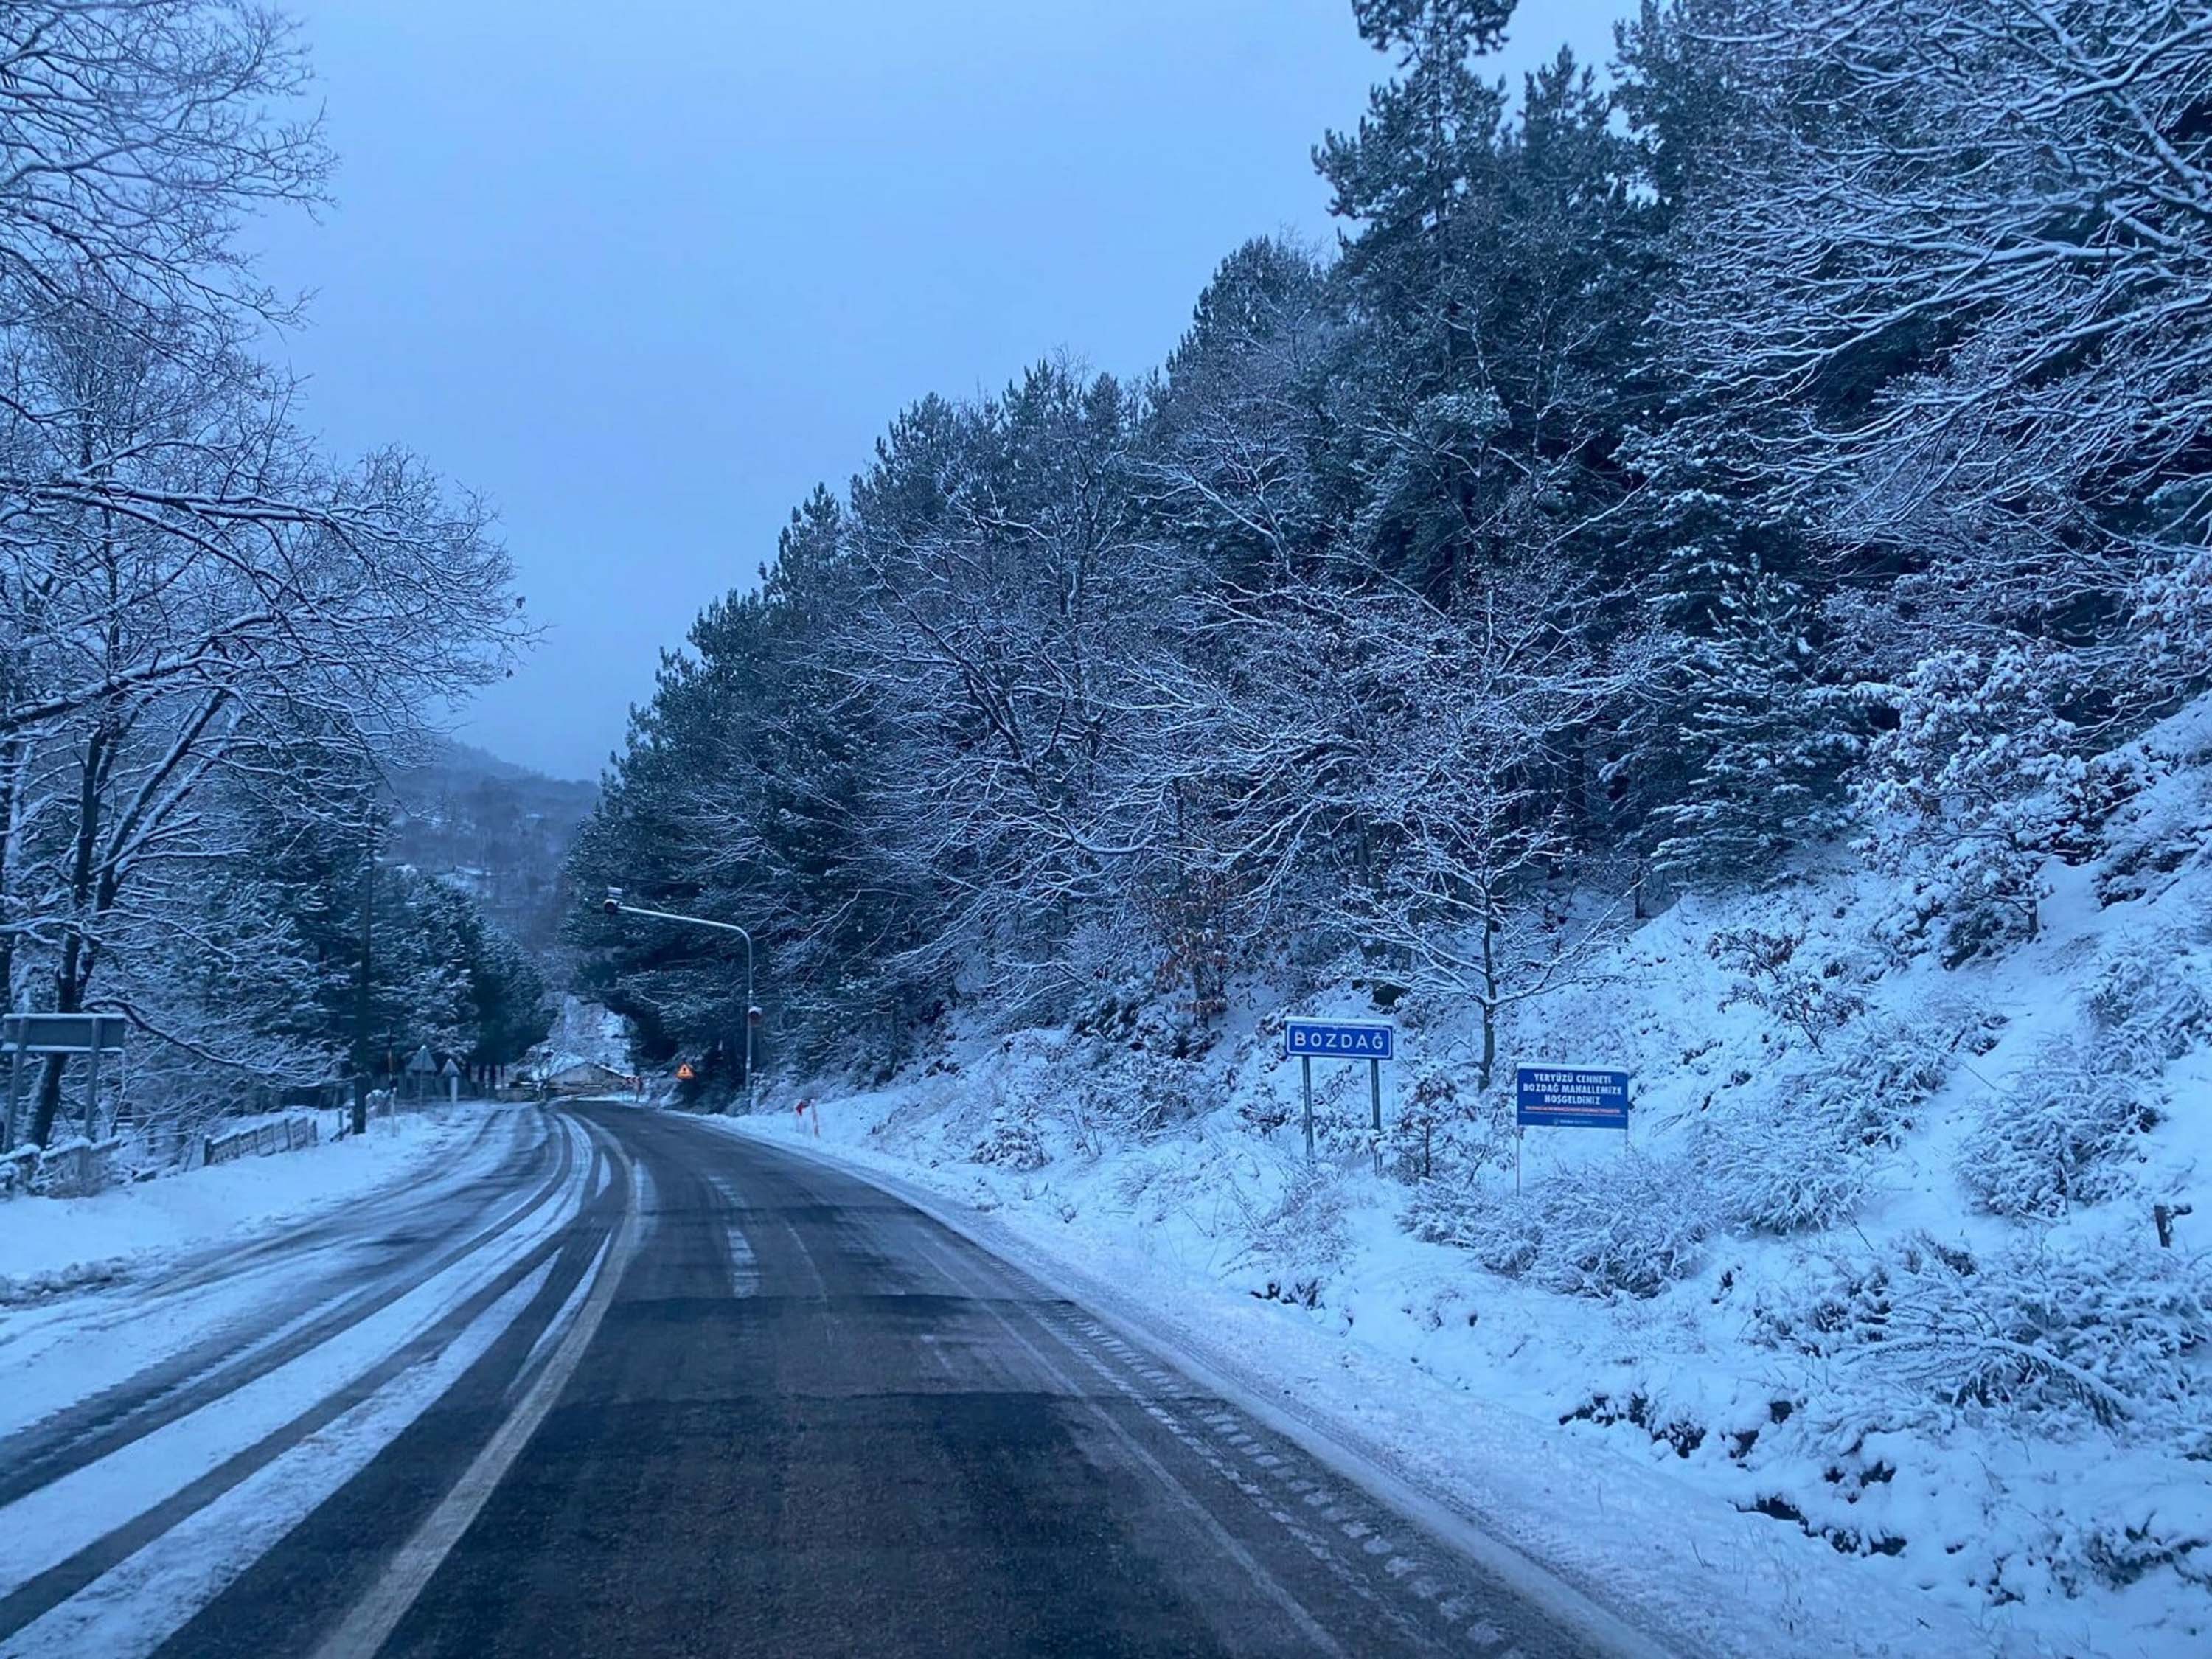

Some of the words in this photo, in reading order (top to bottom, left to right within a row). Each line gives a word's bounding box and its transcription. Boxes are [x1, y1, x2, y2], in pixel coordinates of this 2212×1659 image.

[1294, 1032, 1383, 1050] BOZDAĞ
[1534, 1072, 1574, 1083] YERYÜZÜ
[1523, 1082, 1559, 1093] BOZDAĞ
